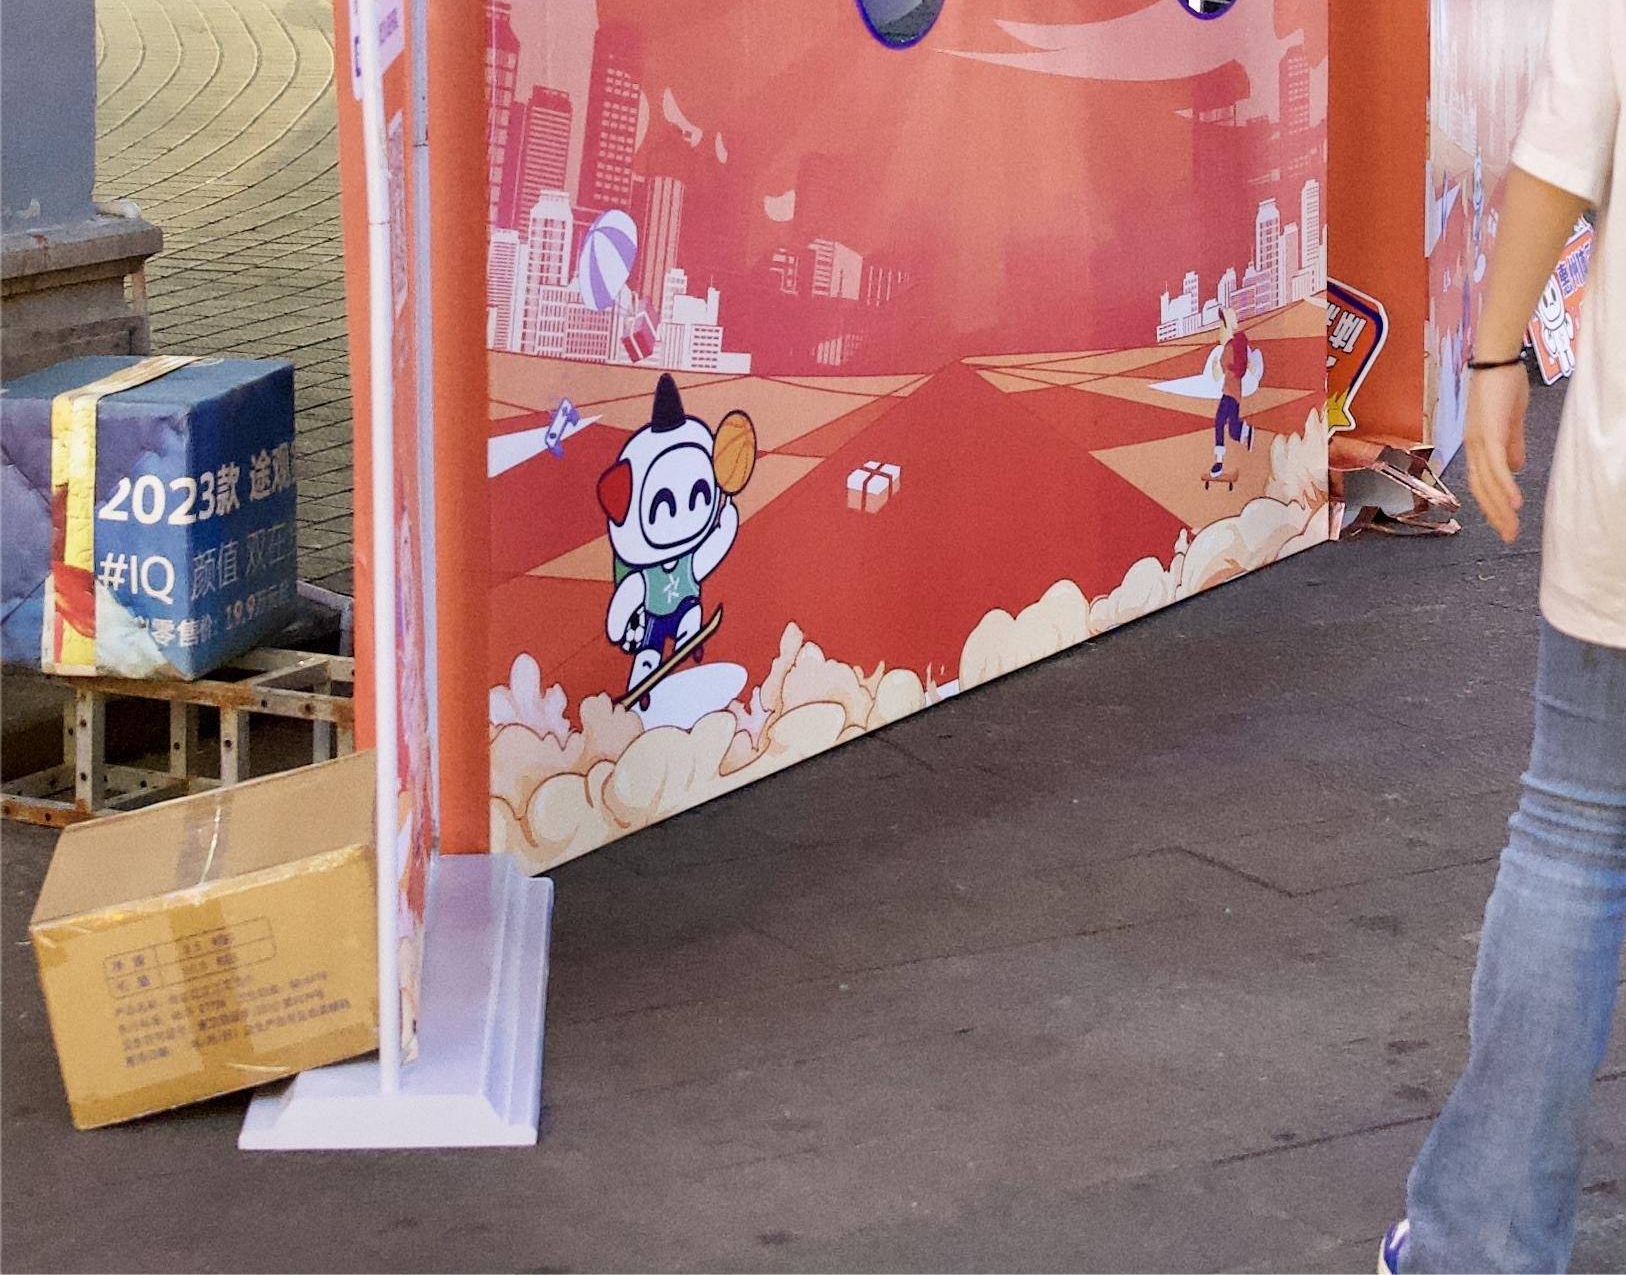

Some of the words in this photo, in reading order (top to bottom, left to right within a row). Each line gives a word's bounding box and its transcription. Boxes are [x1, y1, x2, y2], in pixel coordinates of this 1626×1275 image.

[98, 462, 241, 526] 2023款
[98, 553, 176, 605] #IQ
[191, 539, 240, 601] 颜值
